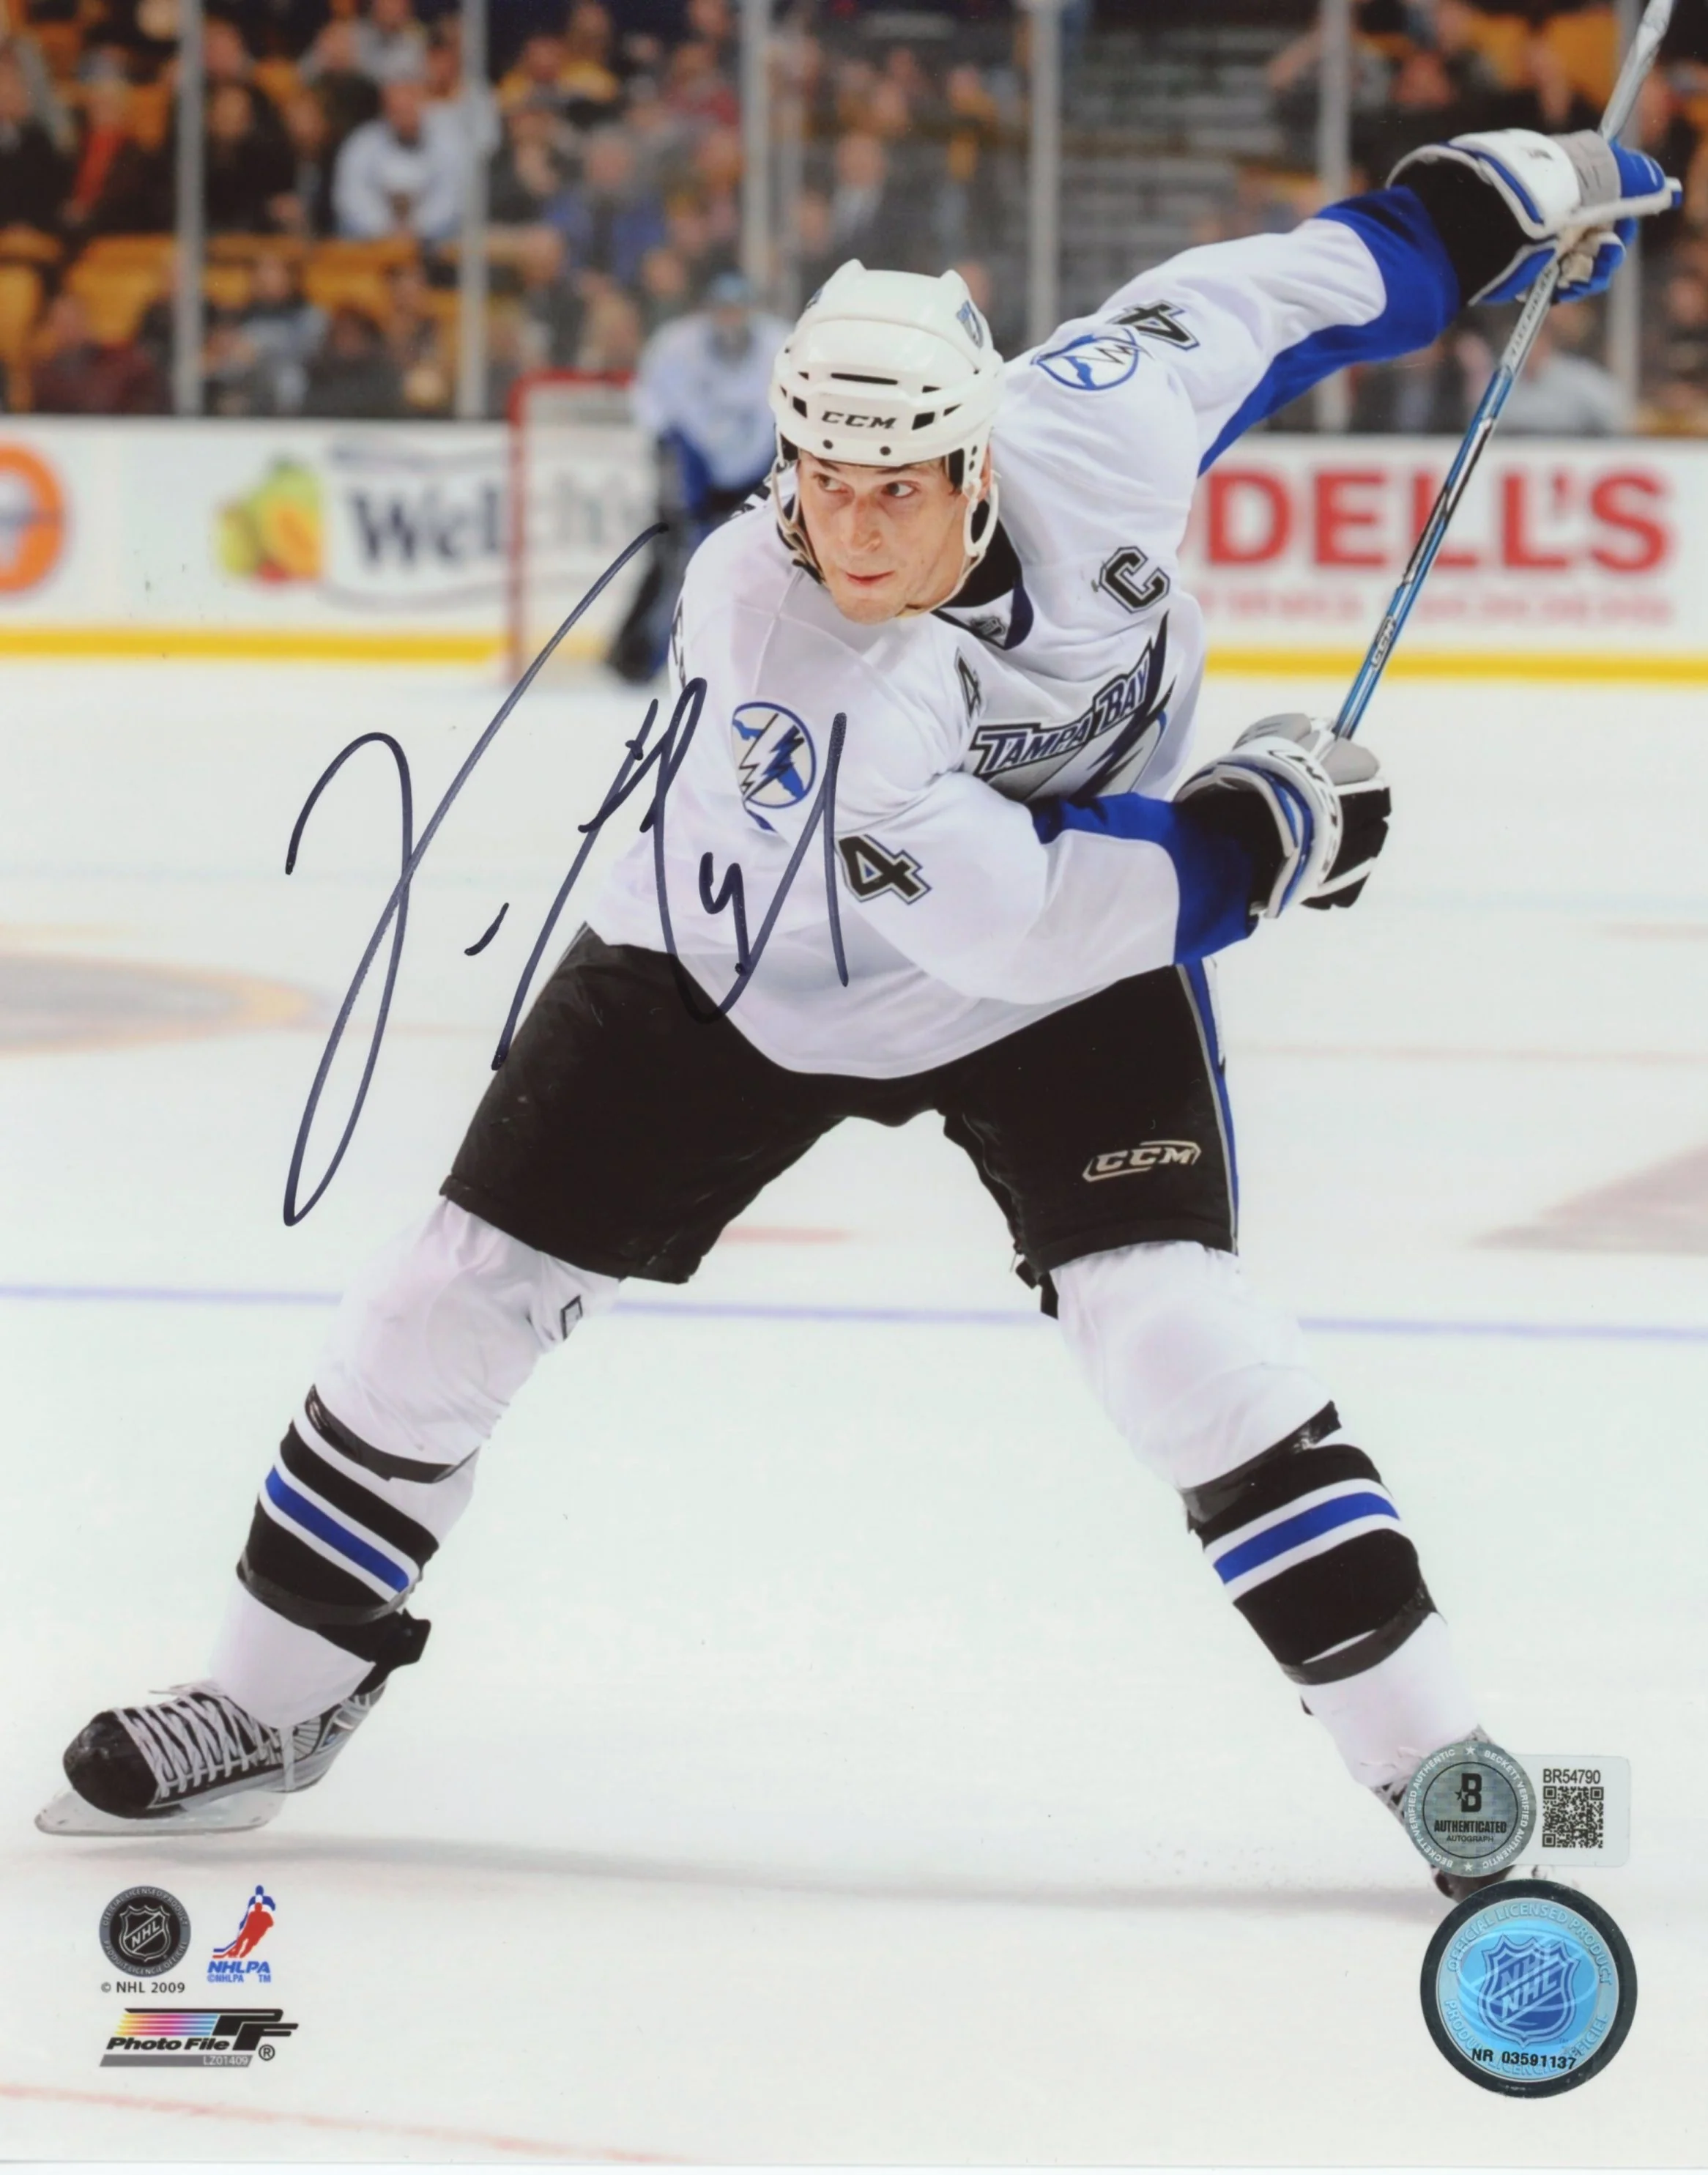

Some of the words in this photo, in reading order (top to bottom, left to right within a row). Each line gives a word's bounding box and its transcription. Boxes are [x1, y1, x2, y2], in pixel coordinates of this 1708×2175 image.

[1107, 300, 1200, 351] 4
[821, 410, 898, 429] CCM
[1099, 546, 1170, 614] C
[973, 714, 1092, 777] TAMPA
[1095, 651, 1151, 732] BAY
[834, 834, 932, 904] 4
[1096, 1147, 1192, 1171] CCM
[1413, 1749, 1455, 1789] AUTHENTIC
[1484, 1750, 1521, 1781] BECKETT
[1542, 1768, 1601, 1784] BR54790
[1460, 1773, 1482, 1812] B
[1517, 1781, 1529, 1827] VERIFIED
[1408, 1790, 1420, 1837] VERIFIED
[1434, 1820, 1507, 1834] AUTHENTICATED
[1416, 1837, 1454, 1868] BECKETT
[1482, 1828, 1525, 1869] AUTHENTIC
[1447, 1913, 1496, 1972] OFFICIAL
[1496, 1903, 1568, 1924] LICENSED
[1568, 1917, 1613, 1985] PRODUCT
[1501, 1968, 1558, 2019] NHL
[1471, 2048, 1494, 2062] NR
[1501, 2050, 1577, 2070] 03591137
